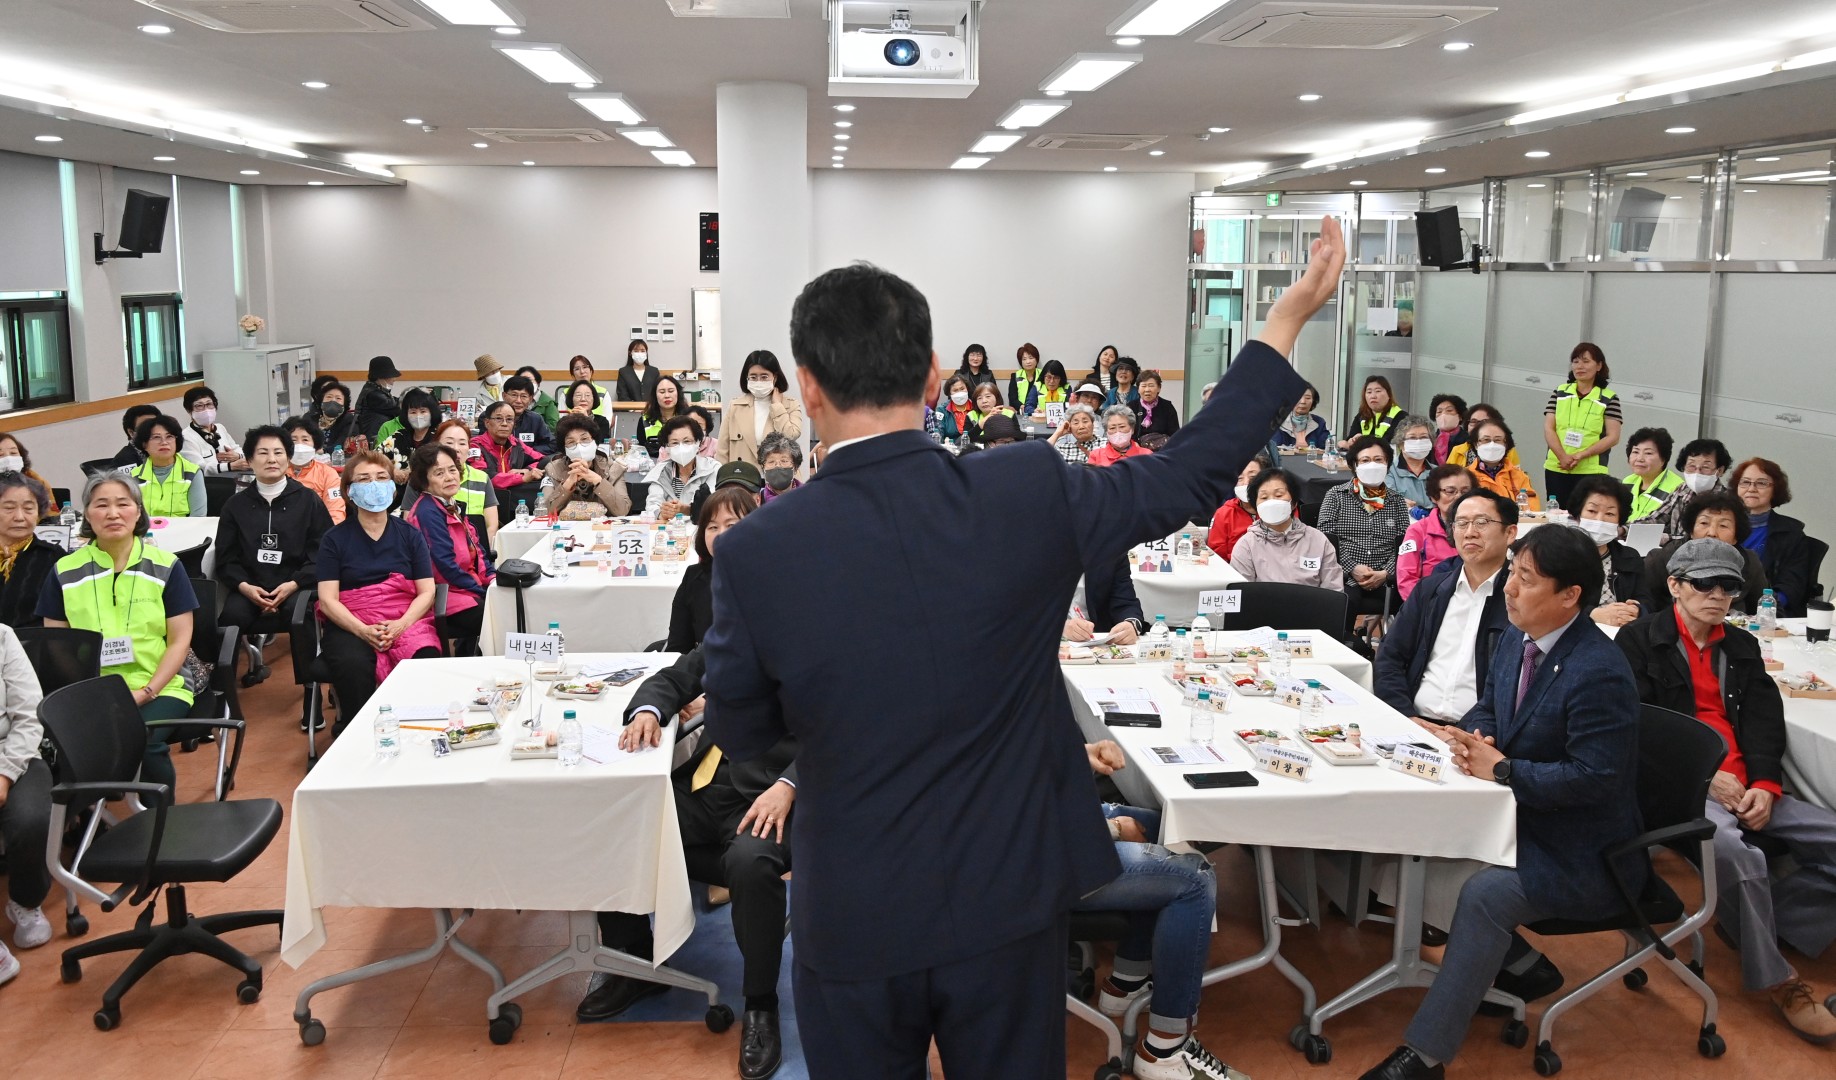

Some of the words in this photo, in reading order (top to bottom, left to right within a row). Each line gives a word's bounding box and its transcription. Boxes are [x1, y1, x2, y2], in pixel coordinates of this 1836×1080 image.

[618, 539, 645, 555] 5조
[262, 552, 279, 562] 6조
[1303, 560, 1318, 569] 4조
[1202, 595, 1236, 607] 내빈석
[509, 639, 553, 656] 내빈석
